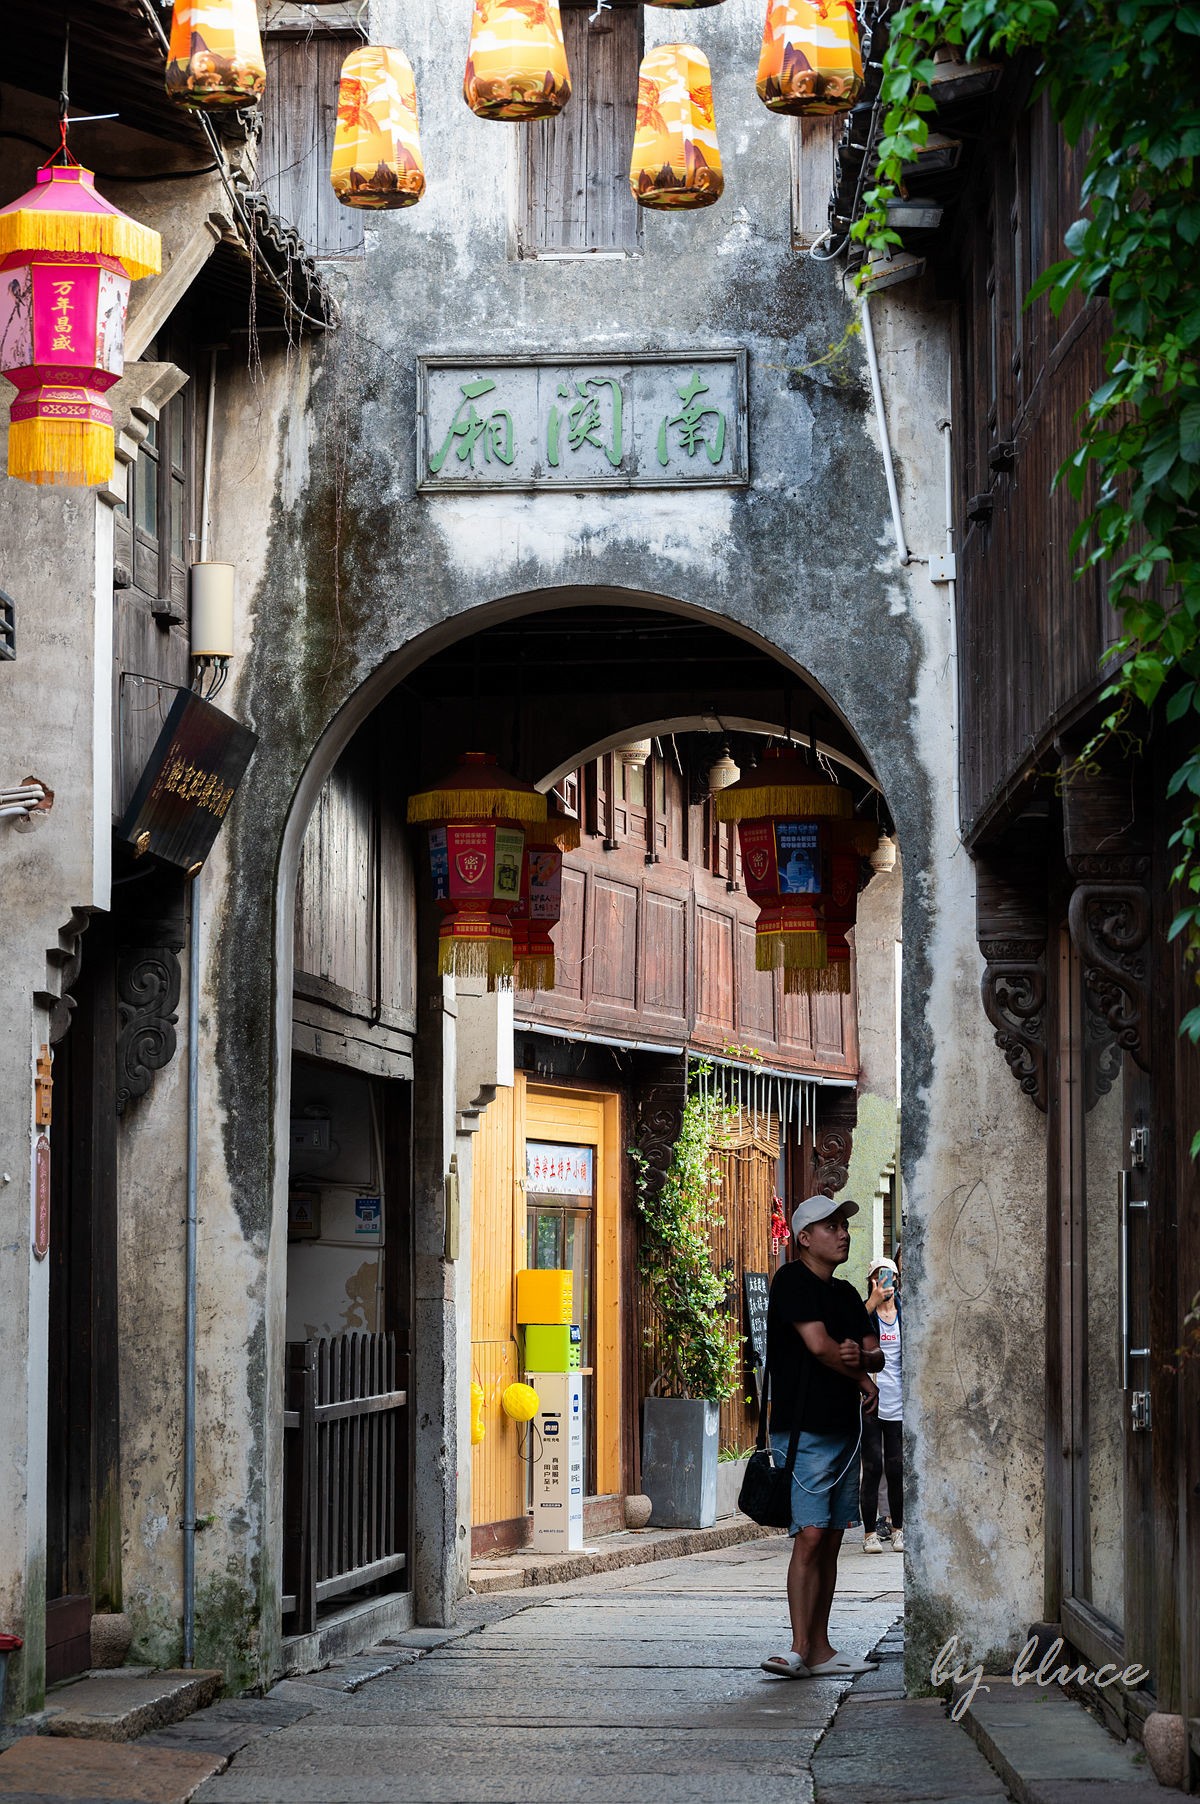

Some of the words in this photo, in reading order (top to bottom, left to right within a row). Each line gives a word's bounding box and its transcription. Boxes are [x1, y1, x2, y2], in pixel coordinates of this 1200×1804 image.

[51, 281, 75, 352] 万年昌盛
[464, 855, 479, 870] 密
